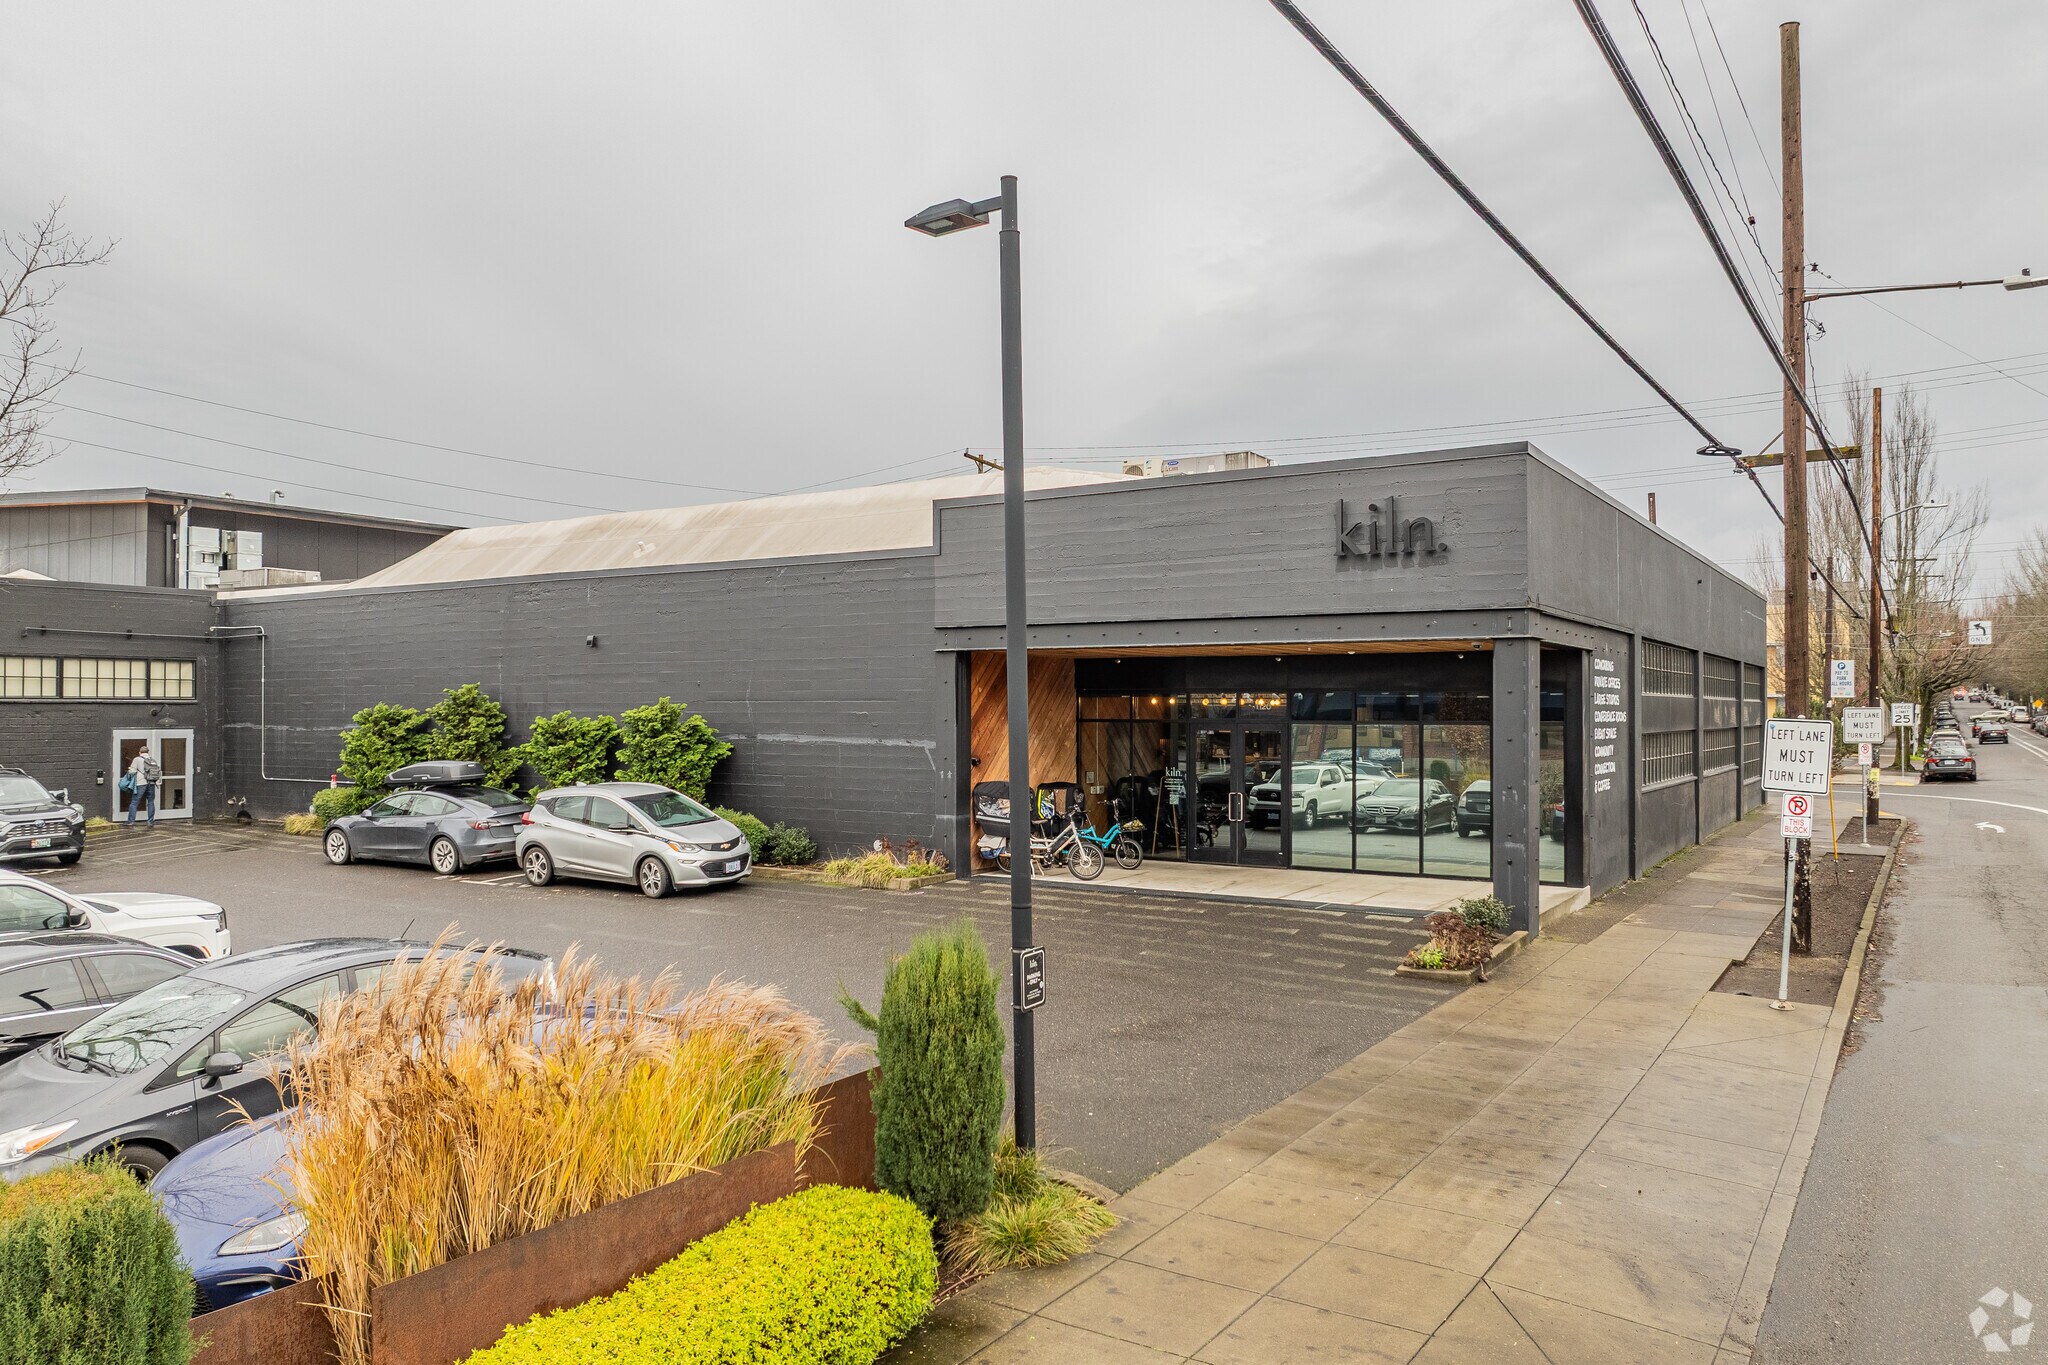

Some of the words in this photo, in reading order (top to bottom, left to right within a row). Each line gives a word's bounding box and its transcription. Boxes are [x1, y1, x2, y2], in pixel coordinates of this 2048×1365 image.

[1333, 496, 1448, 556] kiln.
[1895, 715, 1911, 724] 25
[1771, 729, 1795, 741] LEFT
[1800, 730, 1826, 742] LANE
[1779, 749, 1814, 764] MUST
[1768, 769, 1794, 782] TURN
[1798, 773, 1824, 785] LEFT
[1784, 824, 1808, 834] BLOCK
[1789, 818, 1805, 827] THIS
